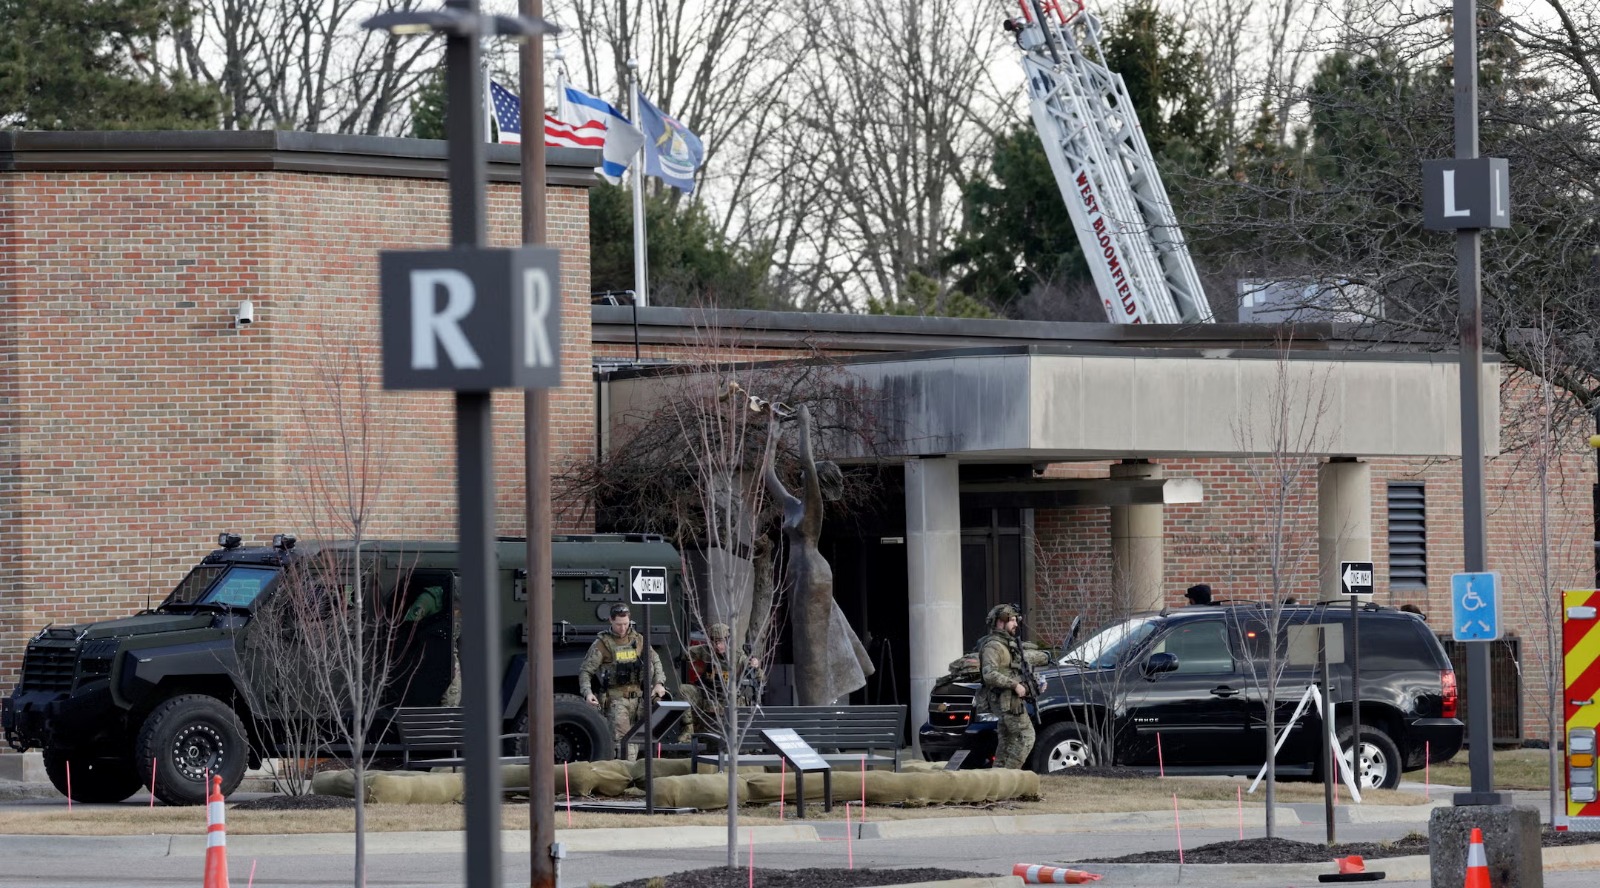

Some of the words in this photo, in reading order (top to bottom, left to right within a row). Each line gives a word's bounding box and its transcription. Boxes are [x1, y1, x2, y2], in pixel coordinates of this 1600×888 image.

[1443, 169, 1470, 217] L
[1496, 169, 1504, 216] L
[1075, 170, 1099, 215] WEST
[1092, 217, 1136, 315] BLOOMFIELD
[409, 268, 483, 370] R
[523, 267, 553, 368] R
[642, 578, 651, 592] ONE
[652, 578, 663, 592] WAY
[1351, 572, 1359, 584] ONE
[1361, 572, 1370, 584] WAY
